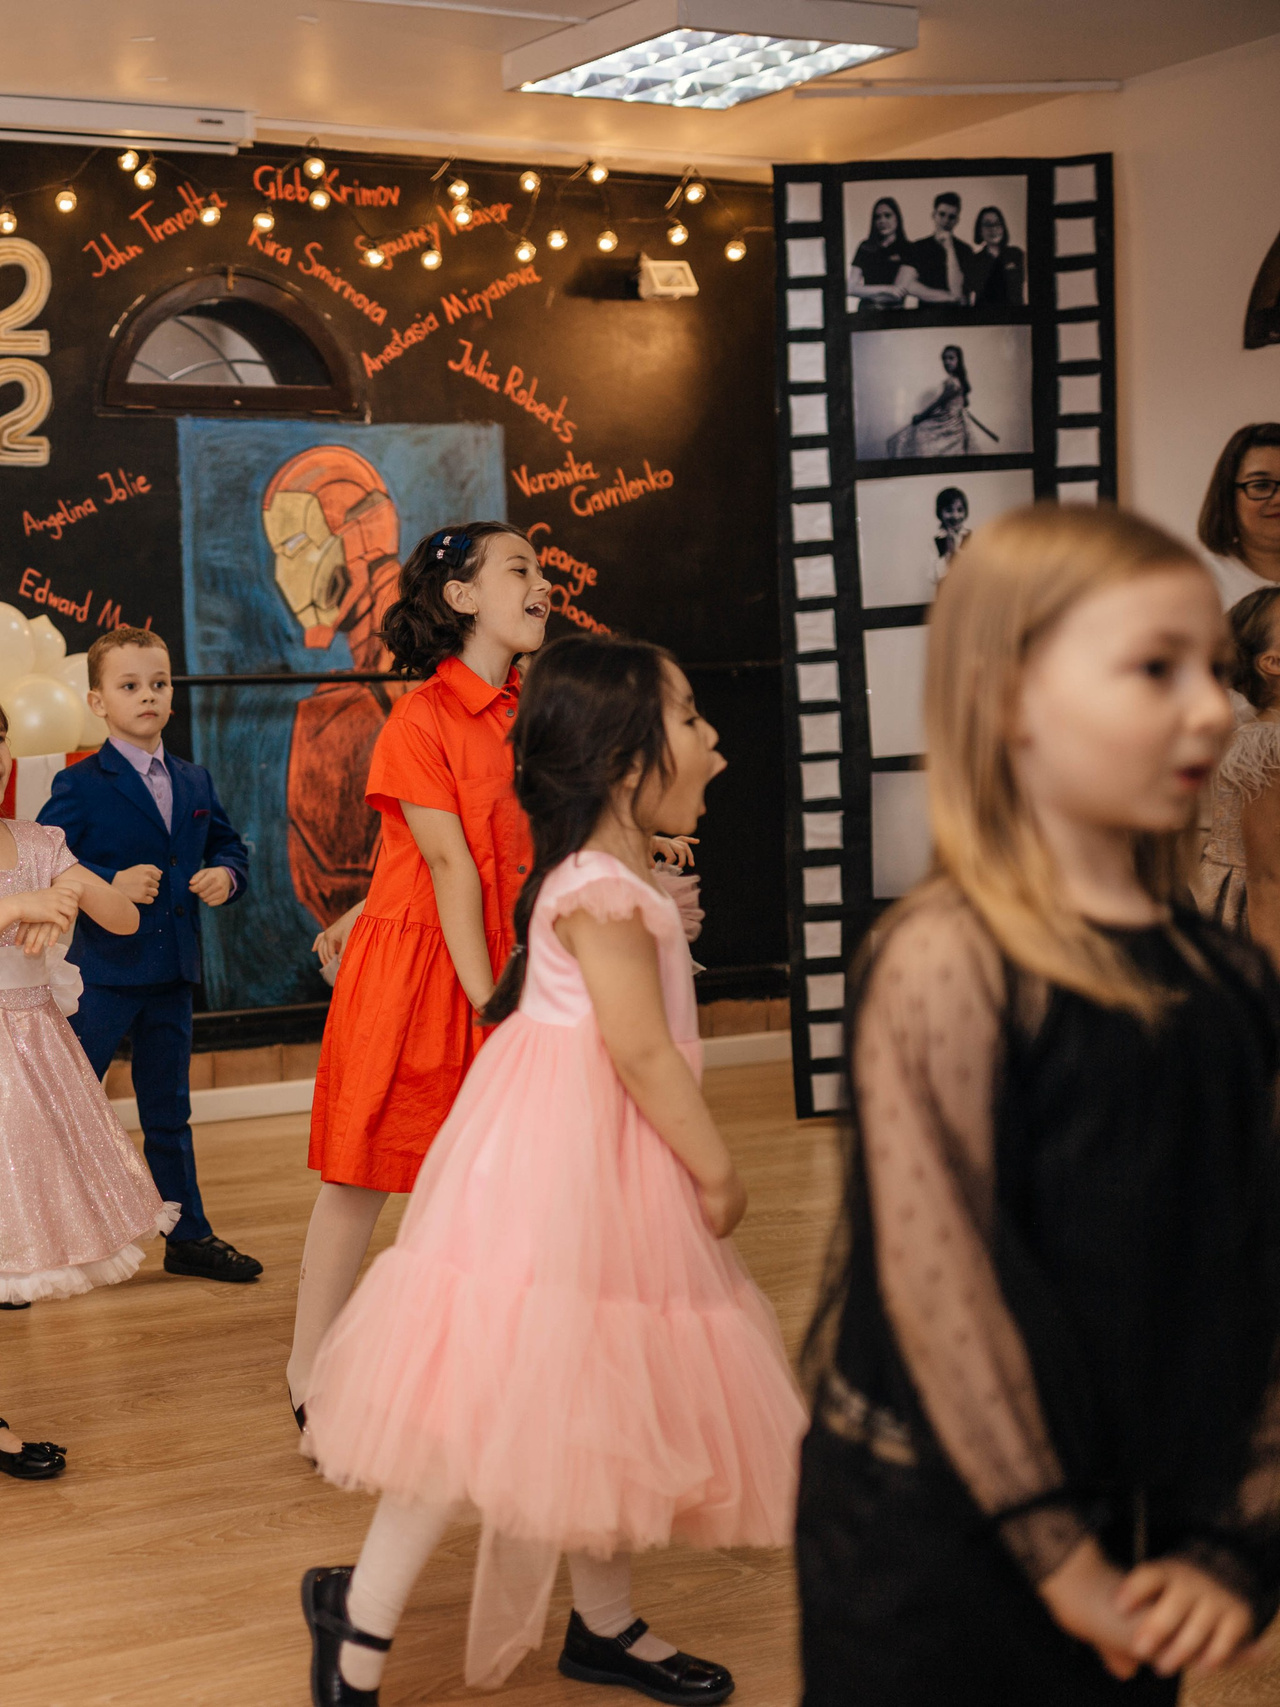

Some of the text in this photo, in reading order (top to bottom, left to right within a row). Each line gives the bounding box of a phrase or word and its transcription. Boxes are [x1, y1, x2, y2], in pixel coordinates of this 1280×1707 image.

[253, 165, 310, 203] Gleb
[82, 232, 144, 278] John
[361, 311, 440, 378] Anastasia
[448, 339, 578, 444] Julia Roberts
[511, 450, 600, 498] Veronika
[22, 467, 153, 540] Angelina Jolie
[18, 567, 93, 623] Edward
